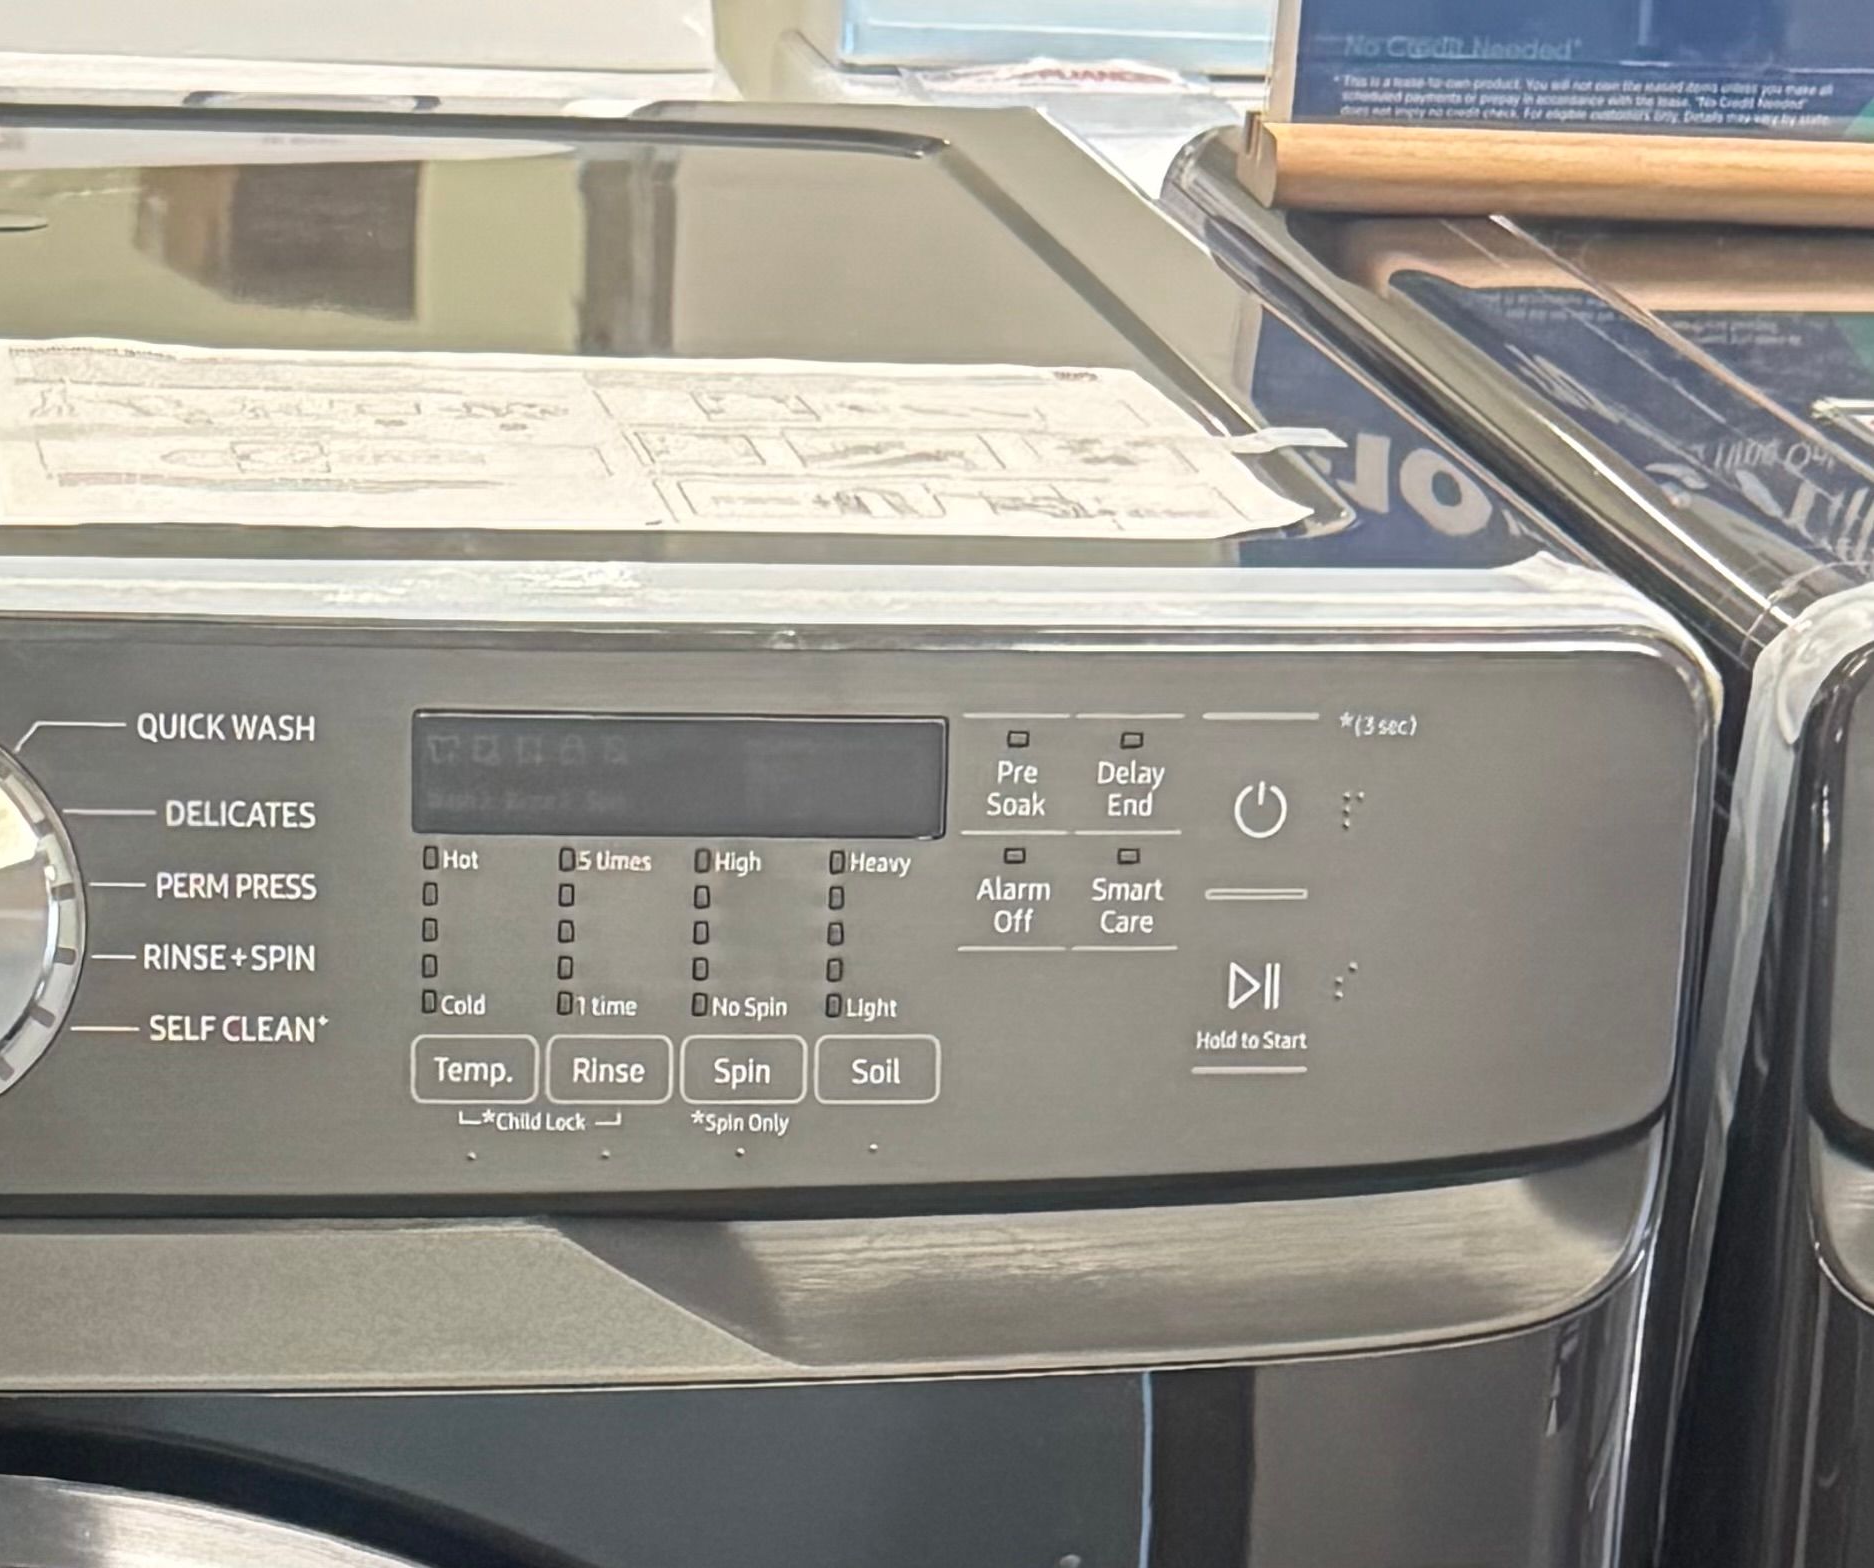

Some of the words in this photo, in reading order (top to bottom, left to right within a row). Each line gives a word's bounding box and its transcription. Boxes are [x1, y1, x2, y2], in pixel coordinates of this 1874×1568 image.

[1343, 34, 1379, 57] No
[1386, 34, 1462, 60] Credit
[1344, 75, 1367, 88] This
[1472, 77, 1521, 92] product.
[1526, 79, 1548, 91] You
[1550, 80, 1570, 91] will
[1572, 81, 1592, 92] not
[1595, 83, 1621, 93] own
[1623, 81, 1642, 93] the
[1760, 85, 1782, 97] you
[1785, 86, 1817, 96] make
[1819, 84, 1834, 96] all
[1404, 92, 1463, 105] payments
[1464, 94, 1477, 104] or
[1479, 95, 1521, 107] prepay
[1608, 96, 1633, 107] with
[1635, 96, 1654, 107] the
[1718, 97, 1755, 110] Credit
[1340, 105, 1370, 116] does
[1371, 107, 1392, 117] not
[1394, 107, 1427, 120] imply
[1427, 108, 1444, 118] no
[1445, 107, 1480, 118] credit
[1523, 108, 1543, 120] For
[1545, 110, 1587, 122] eligible
[1683, 112, 1723, 124] Details
[1726, 114, 1752, 125] may
[137, 712, 226, 743] QUICK
[231, 714, 315, 742] WASH
[1378, 715, 1418, 736] sec)
[997, 760, 1038, 784] Pre
[1097, 759, 1165, 791] Delay
[166, 799, 316, 829] DELICATES
[986, 791, 1045, 816] Soak
[1108, 793, 1153, 817] End
[443, 849, 479, 870] Hot
[577, 850, 592, 871] 5
[596, 850, 652, 871] times
[715, 850, 761, 877] High
[850, 852, 912, 878] Heavy
[156, 871, 229, 899] PERM
[236, 873, 317, 900] PRESS
[976, 876, 1051, 901] Alarm
[1091, 877, 1164, 902] Smart
[993, 907, 1034, 933] Off
[1100, 910, 1154, 934] Care
[441, 993, 486, 1015] Cold
[577, 996, 586, 1016] 1
[591, 997, 637, 1016] time
[712, 997, 741, 1017] No
[744, 996, 788, 1021] Spin
[847, 998, 897, 1021] Light
[149, 1014, 217, 1041] SELF
[1196, 1031, 1237, 1049] Hold
[1241, 1032, 1260, 1049] to
[1263, 1030, 1307, 1049] Start
[433, 1056, 513, 1088] Temp.
[573, 1057, 646, 1083] Rinse
[714, 1057, 771, 1090] Spin
[852, 1057, 901, 1084] Soil
[546, 1112, 586, 1131] Lock
[748, 1113, 790, 1136] Only
